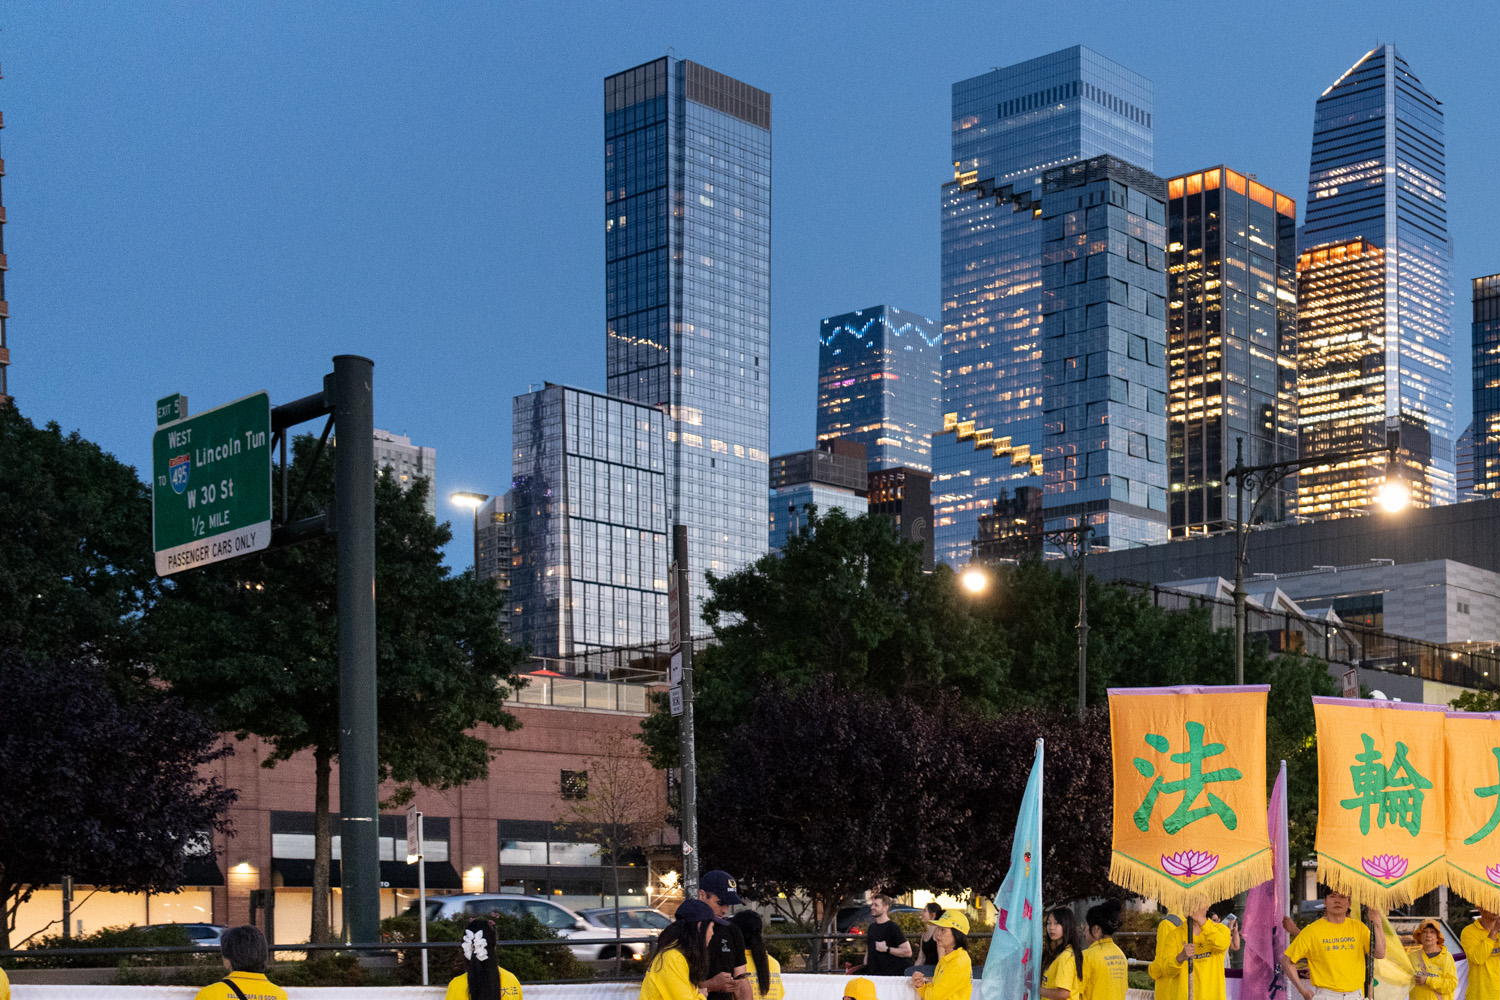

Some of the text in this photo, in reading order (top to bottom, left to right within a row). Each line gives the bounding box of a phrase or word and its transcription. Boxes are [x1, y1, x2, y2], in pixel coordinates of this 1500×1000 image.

[157, 399, 180, 418] EXIT 5
[168, 429, 192, 449] WEST
[195, 438, 241, 467] Lincoln
[245, 430, 266, 450] Tun
[158, 465, 187, 487] TO 495
[187, 478, 234, 509] W 30 St
[209, 510, 230, 529] MILE
[168, 532, 257, 570] PASSENGER CARS ONLY
[1132, 720, 1243, 836] 法
[1339, 732, 1434, 838] 輪
